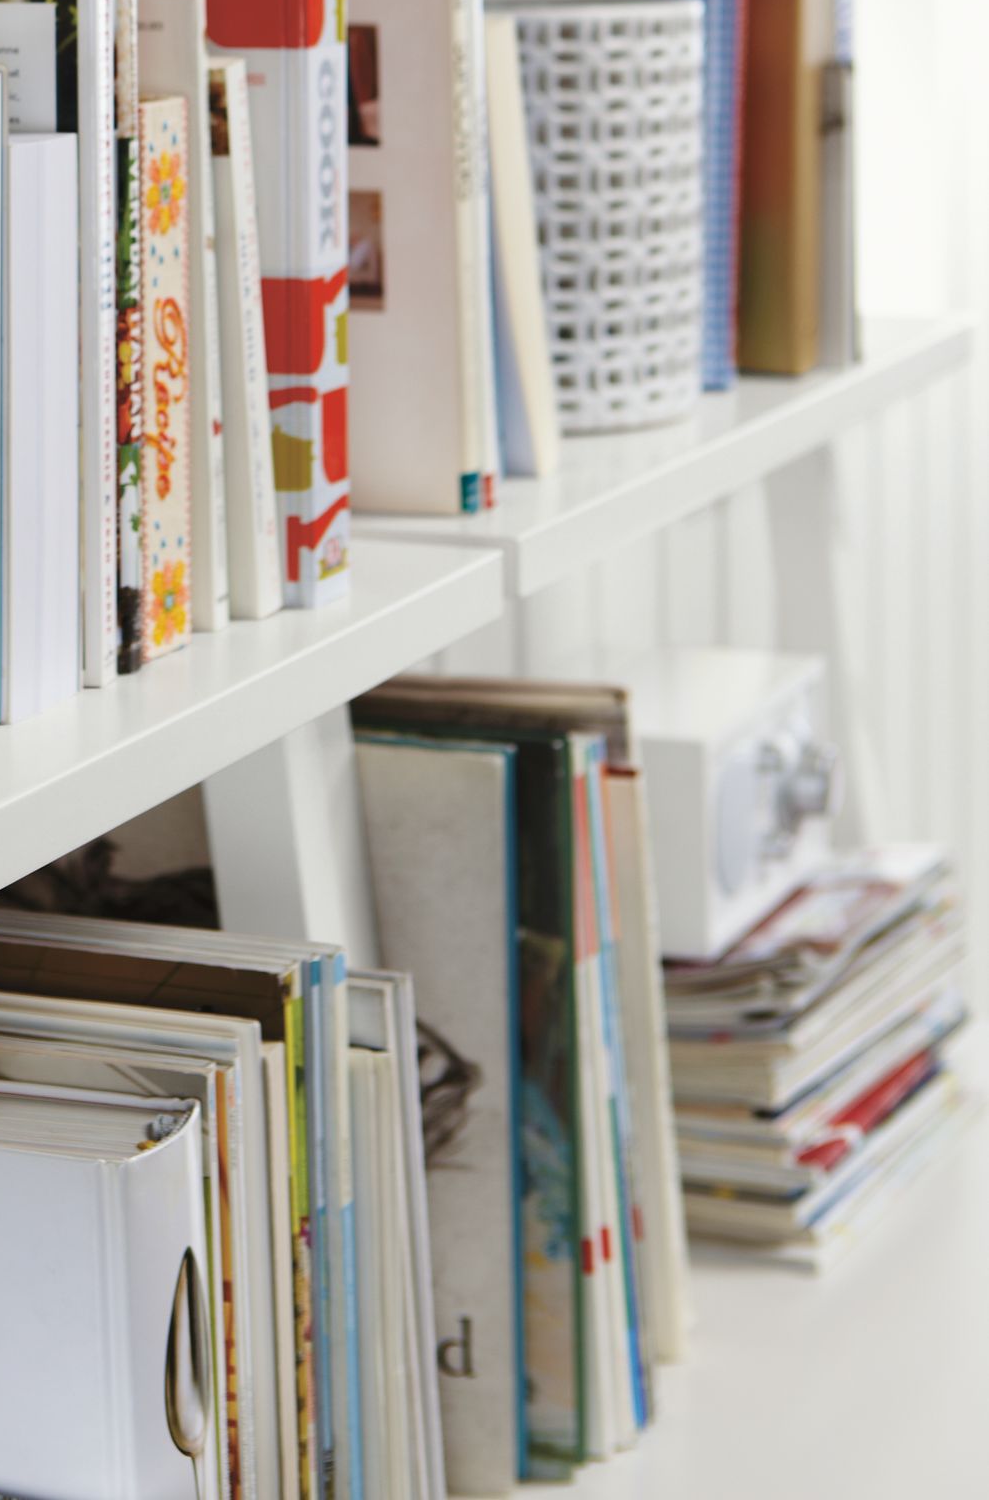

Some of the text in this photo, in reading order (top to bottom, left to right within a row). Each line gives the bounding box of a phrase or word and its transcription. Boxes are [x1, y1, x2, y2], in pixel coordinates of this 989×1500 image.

[317, 58, 336, 250] COOK
[145, 296, 188, 501] Recipe
[436, 1316, 477, 1380] d
